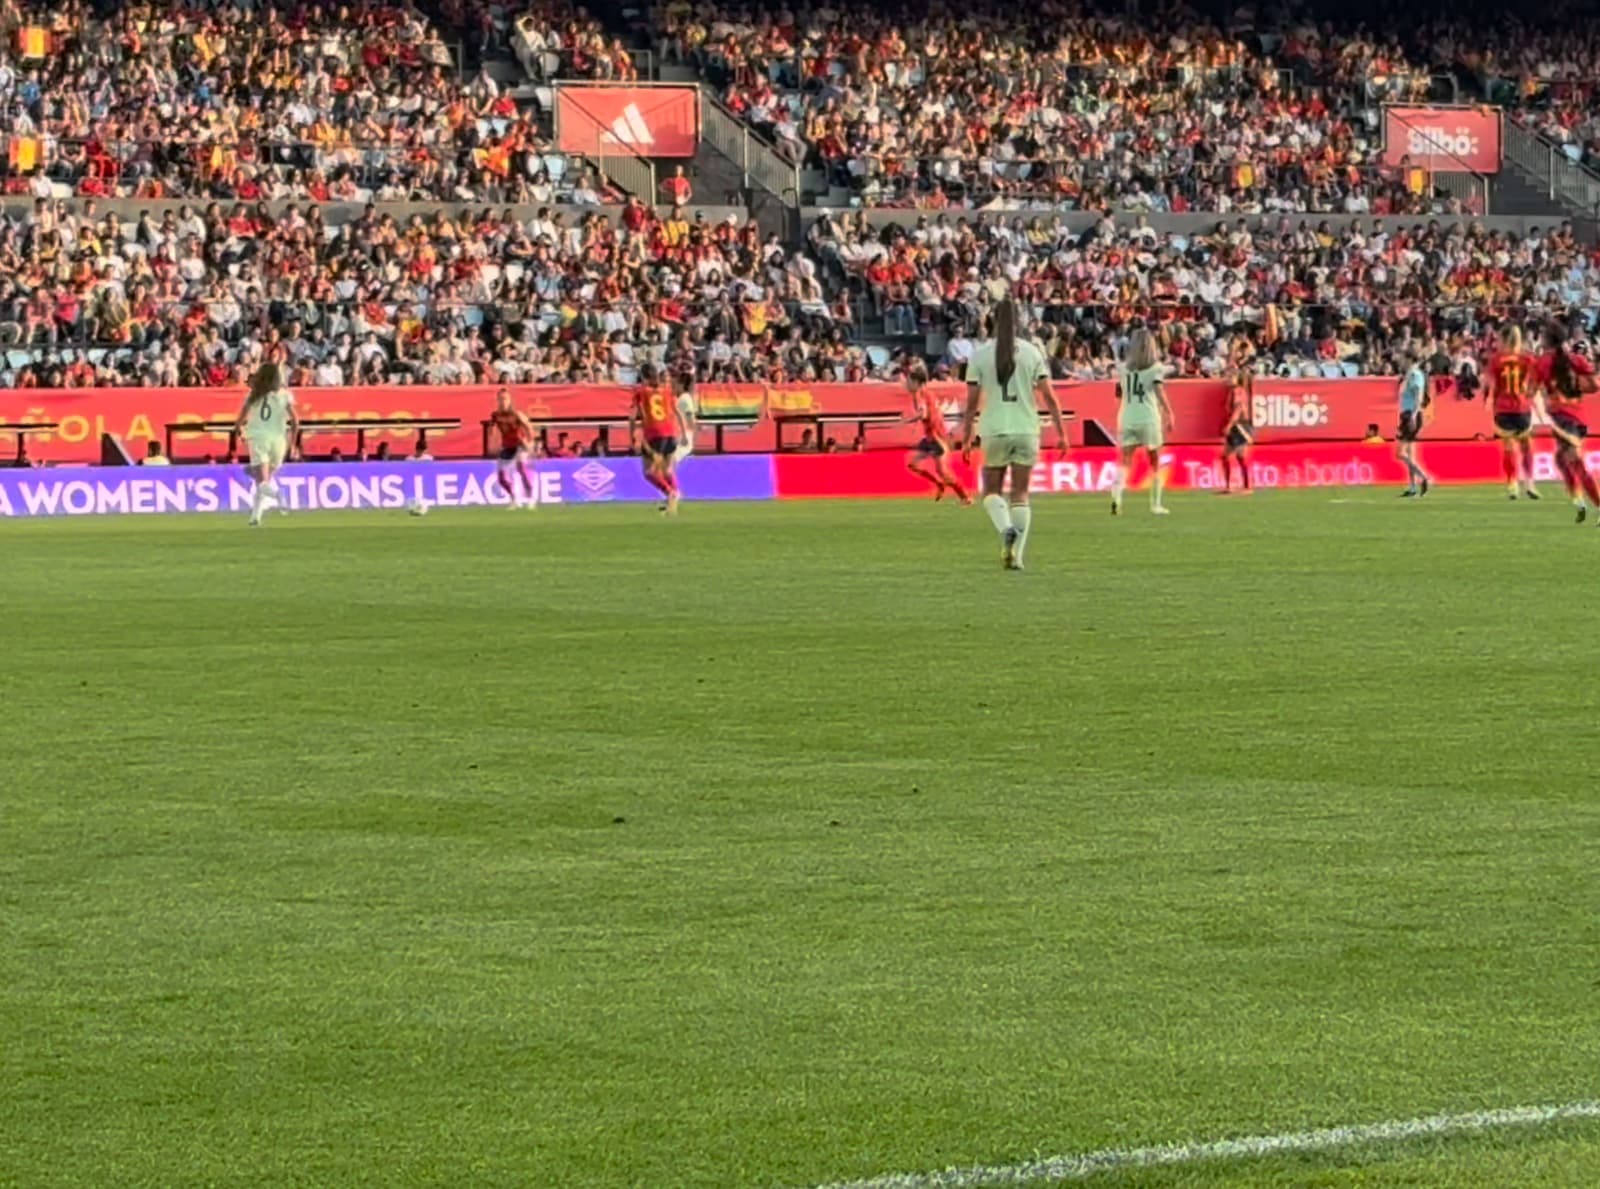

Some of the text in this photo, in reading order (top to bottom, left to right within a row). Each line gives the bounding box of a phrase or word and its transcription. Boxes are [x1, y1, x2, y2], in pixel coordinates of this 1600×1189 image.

[1126, 372, 1145, 404] 14
[259, 395, 272, 421] 6
[649, 394, 666, 420] 6
[1304, 456, 1374, 486] bordo
[17, 477, 218, 515] WOMEN'S
